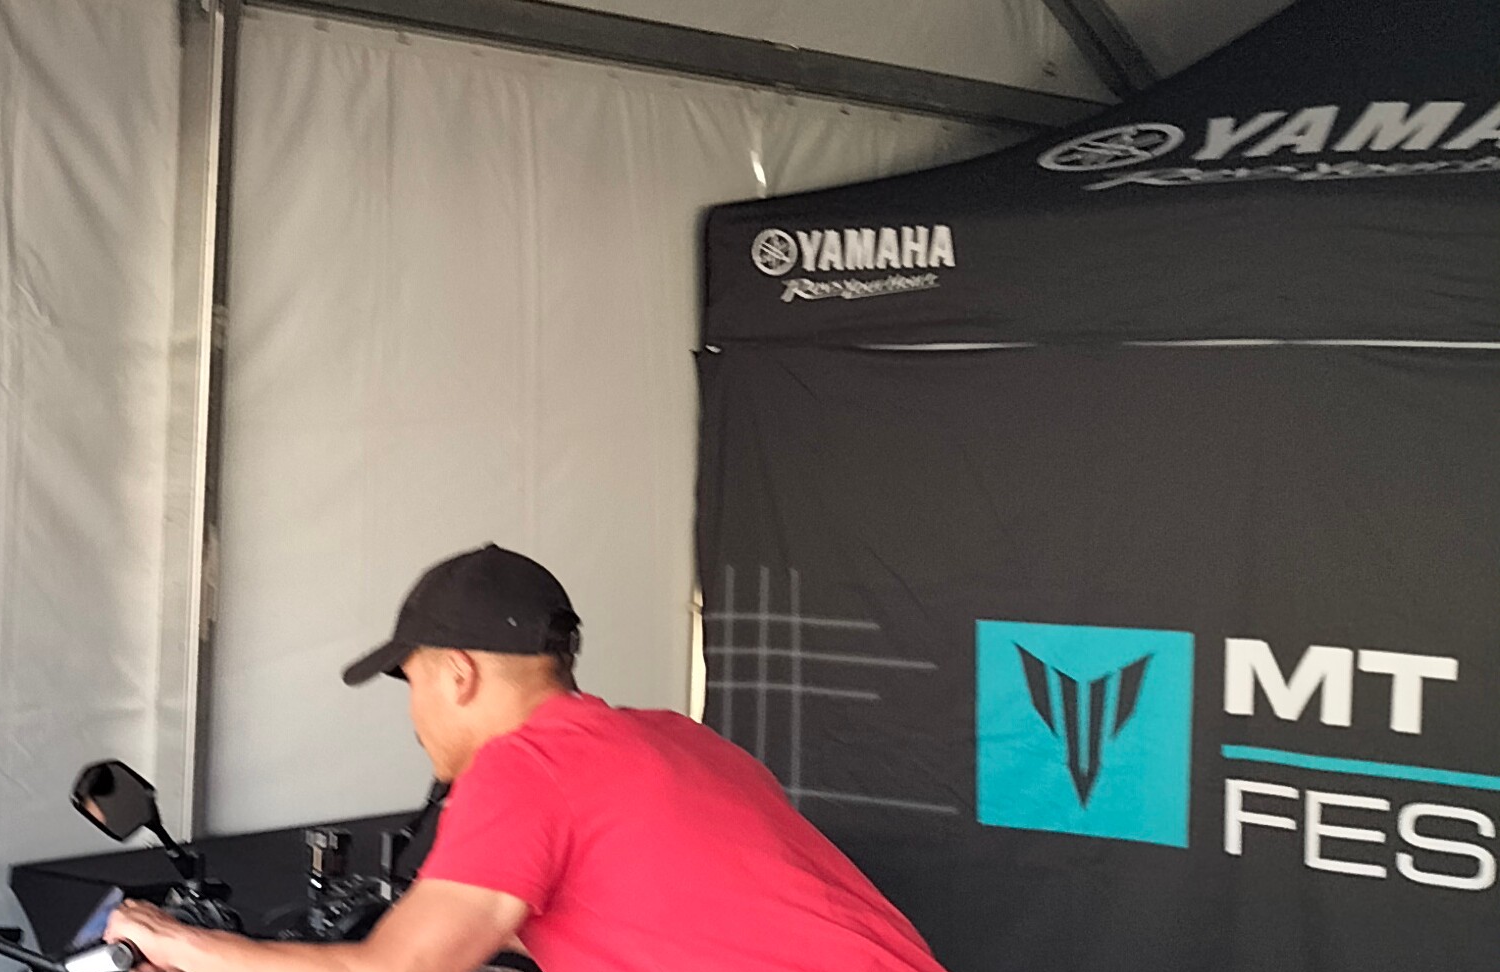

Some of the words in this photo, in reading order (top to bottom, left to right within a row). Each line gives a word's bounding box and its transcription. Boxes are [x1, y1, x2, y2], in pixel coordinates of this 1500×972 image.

[795, 224, 956, 272] YAMAHA
[1223, 637, 1459, 734] MT
[1223, 778, 1498, 891] FES
